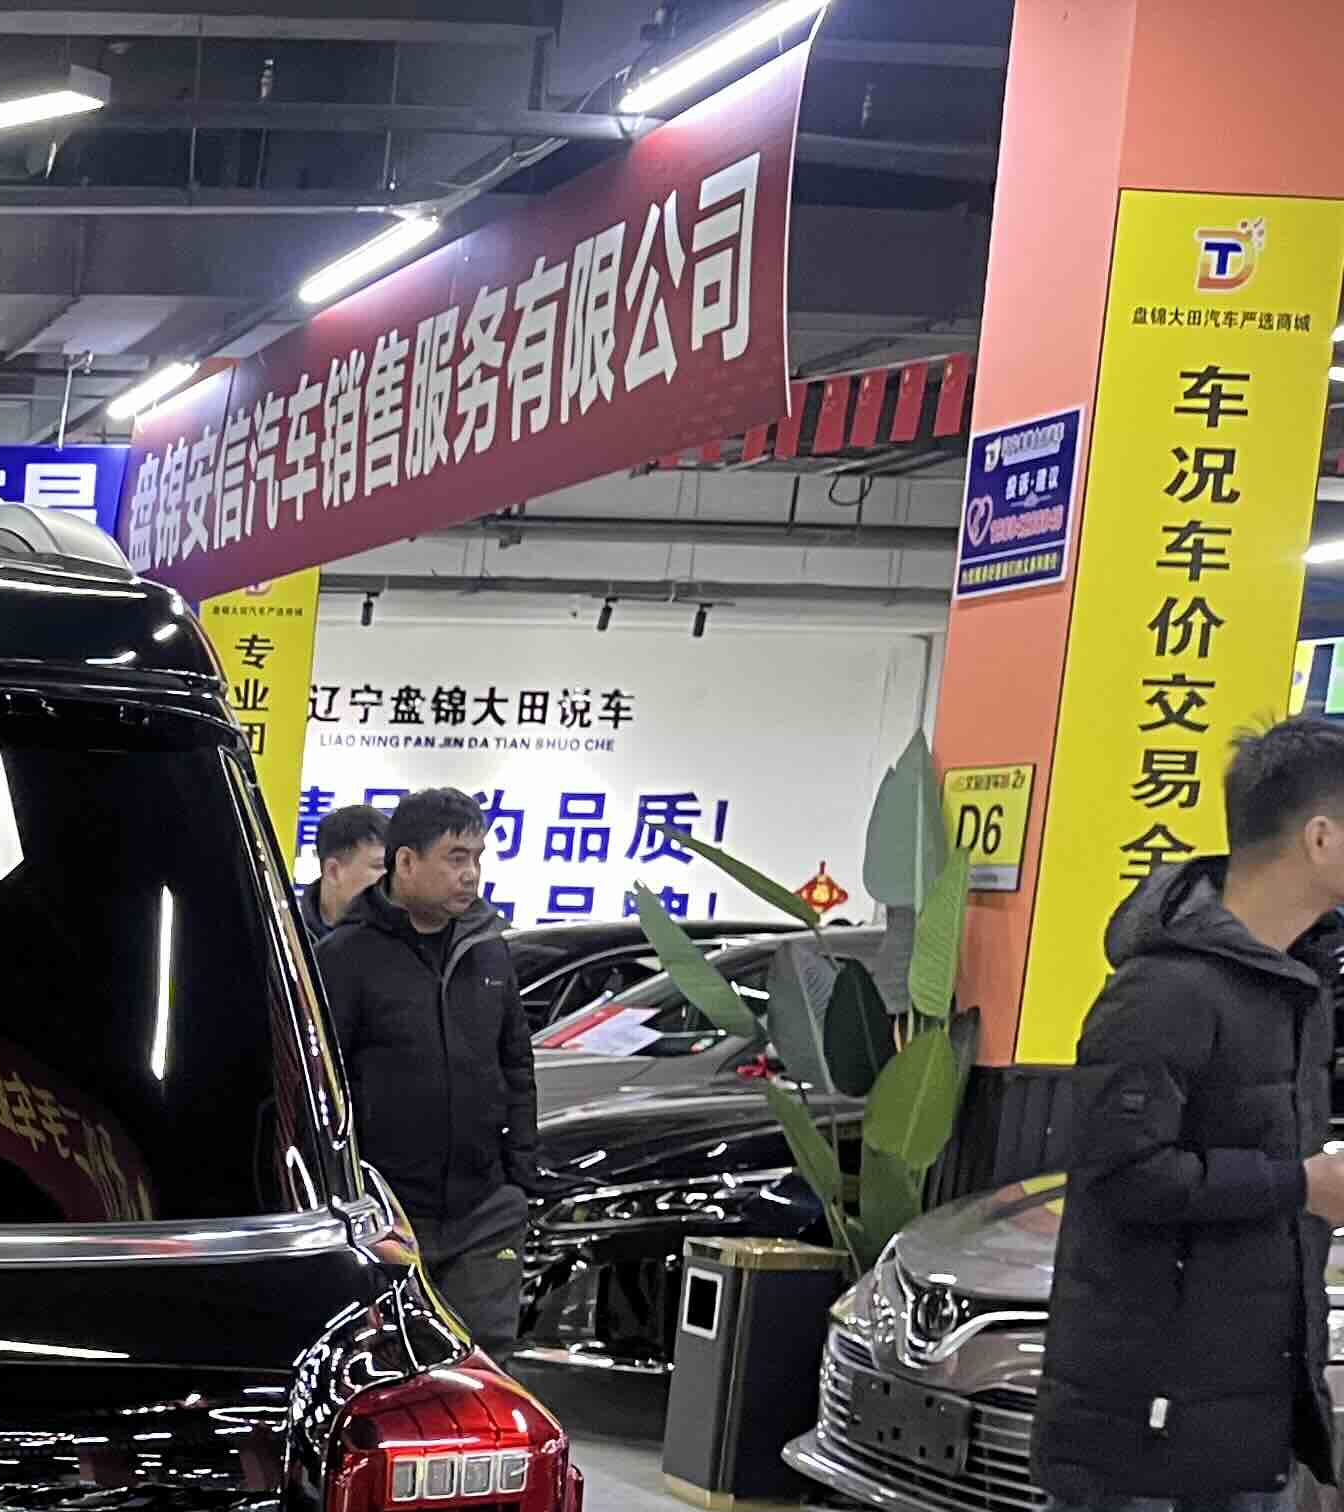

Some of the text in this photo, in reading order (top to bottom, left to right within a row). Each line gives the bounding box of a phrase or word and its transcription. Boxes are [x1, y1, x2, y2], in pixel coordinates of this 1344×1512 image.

[1132, 307, 1312, 332] 盘锦大田汽车严选商城
[128, 151, 760, 572] 盘锦安信汽车销售服务有限公司
[309, 684, 635, 729] 辽宁盘锦大田说车
[320, 734, 355, 747] LIAO
[360, 735, 399, 748] NING
[403, 736, 434, 748] PAN
[468, 737, 489, 749] DA
[494, 738, 530, 750] TIAN
[584, 739, 614, 751] CHE
[956, 804, 1004, 855] D6
